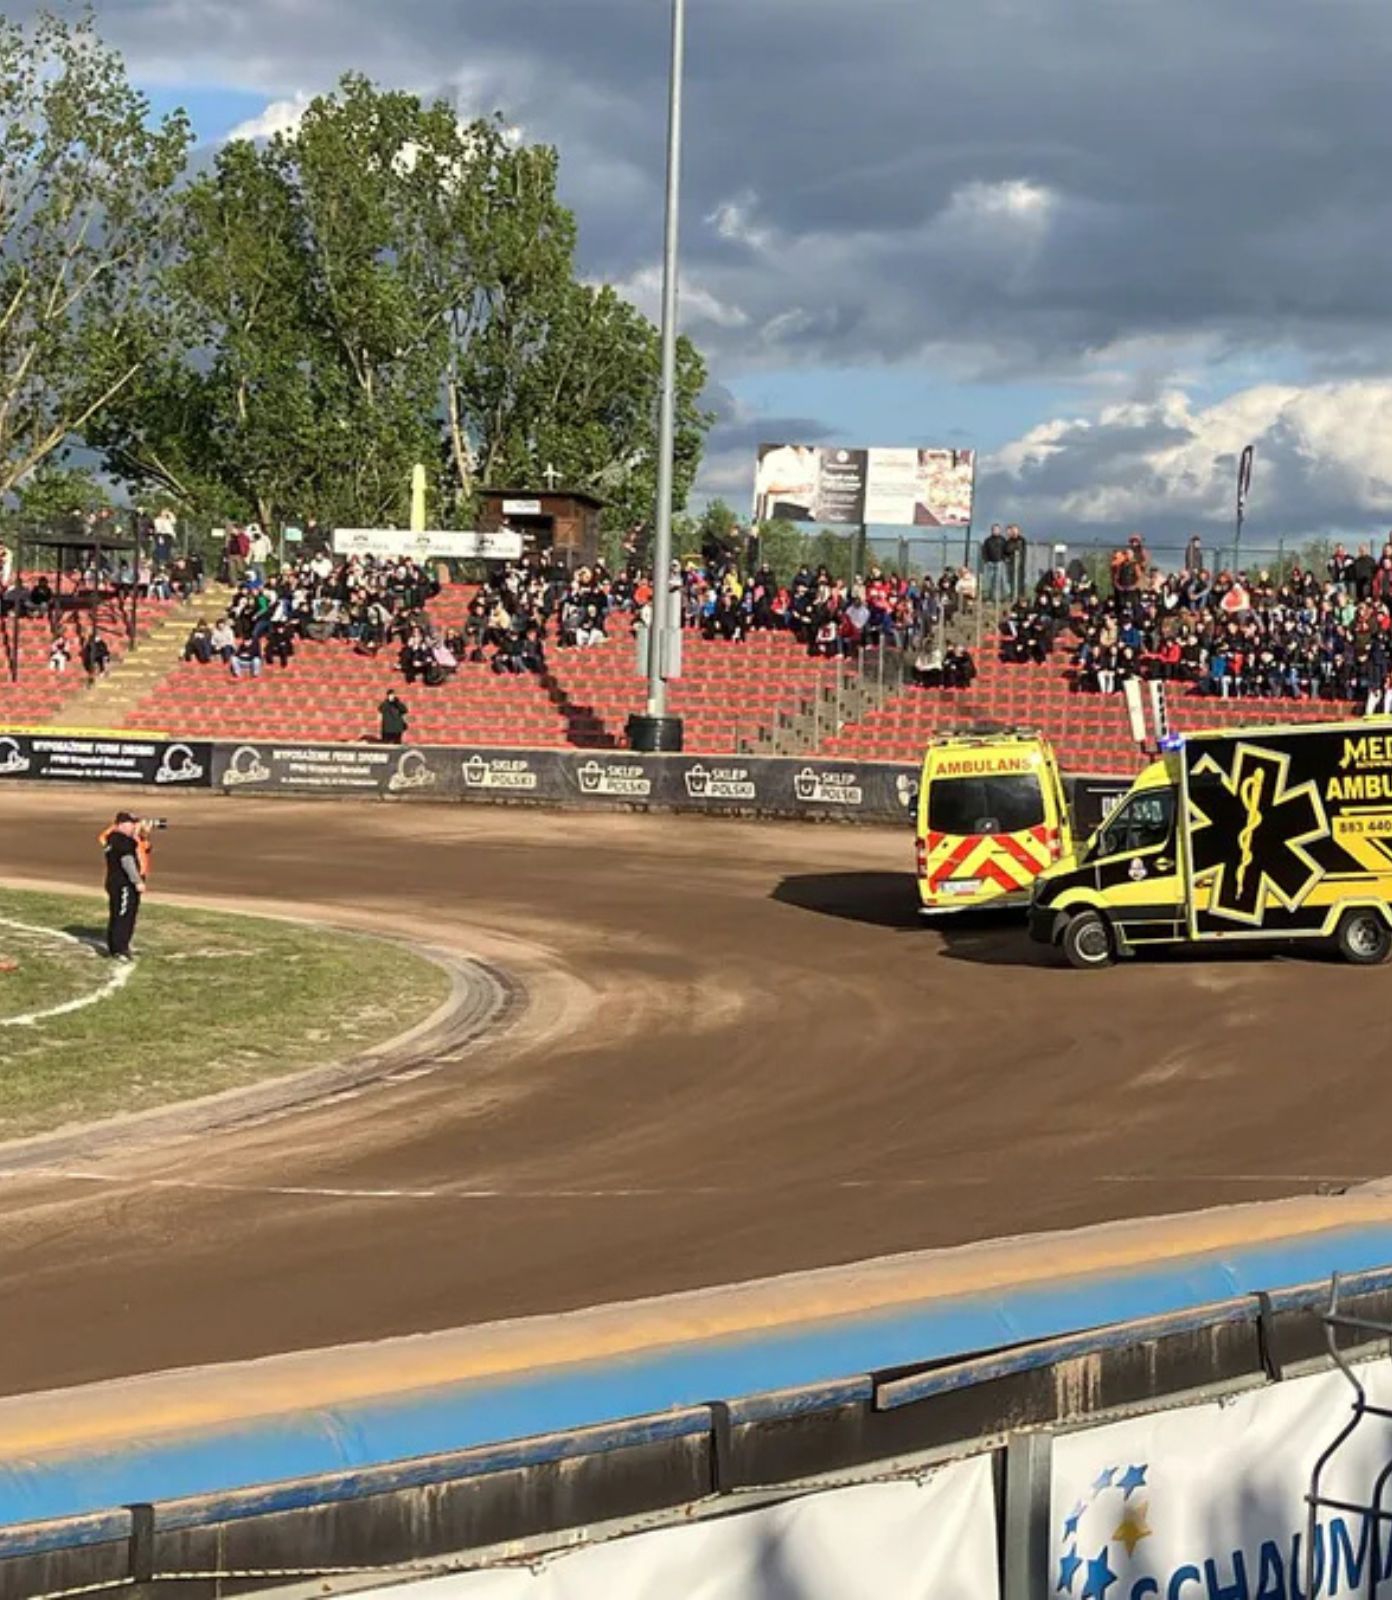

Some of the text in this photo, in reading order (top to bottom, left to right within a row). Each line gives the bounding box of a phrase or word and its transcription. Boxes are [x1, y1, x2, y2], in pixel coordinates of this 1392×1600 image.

[491, 759, 528, 772] SKLEP
[607, 764, 644, 778] SKLEP
[935, 758, 1032, 775] AMBULANS
[490, 773, 533, 786] POLSKI
[711, 768, 748, 781] SKLEP
[821, 772, 857, 785] SKLEP
[606, 780, 648, 793] POLSKI
[710, 783, 753, 796] POLSKI
[820, 788, 860, 802] POLSKI
[1367, 819, 1392, 832] 440
